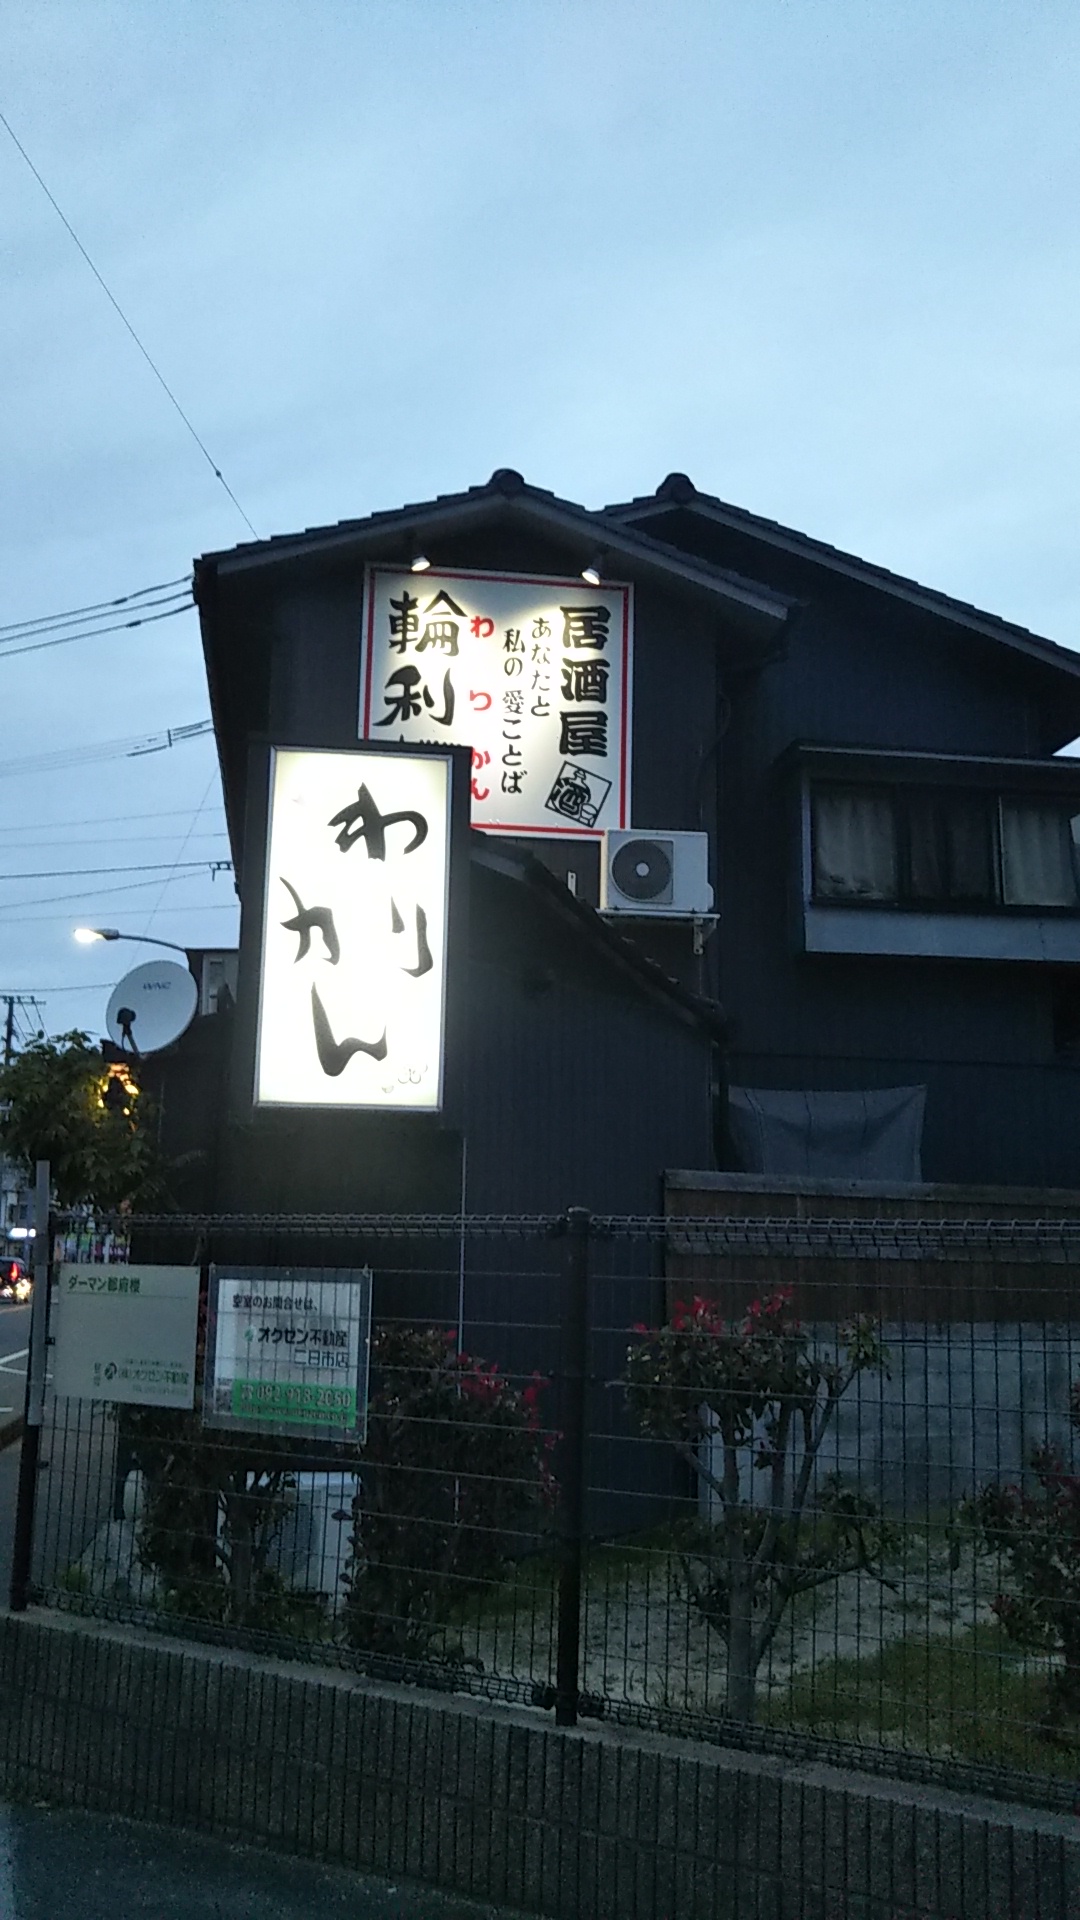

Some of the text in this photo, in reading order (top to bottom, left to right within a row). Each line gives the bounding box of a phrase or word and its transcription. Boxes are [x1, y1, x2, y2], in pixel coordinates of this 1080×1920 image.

[530, 617, 552, 717] あなたと
[558, 605, 611, 757] 居酒屋
[258, 1327, 347, 1347] オクセン不動産
